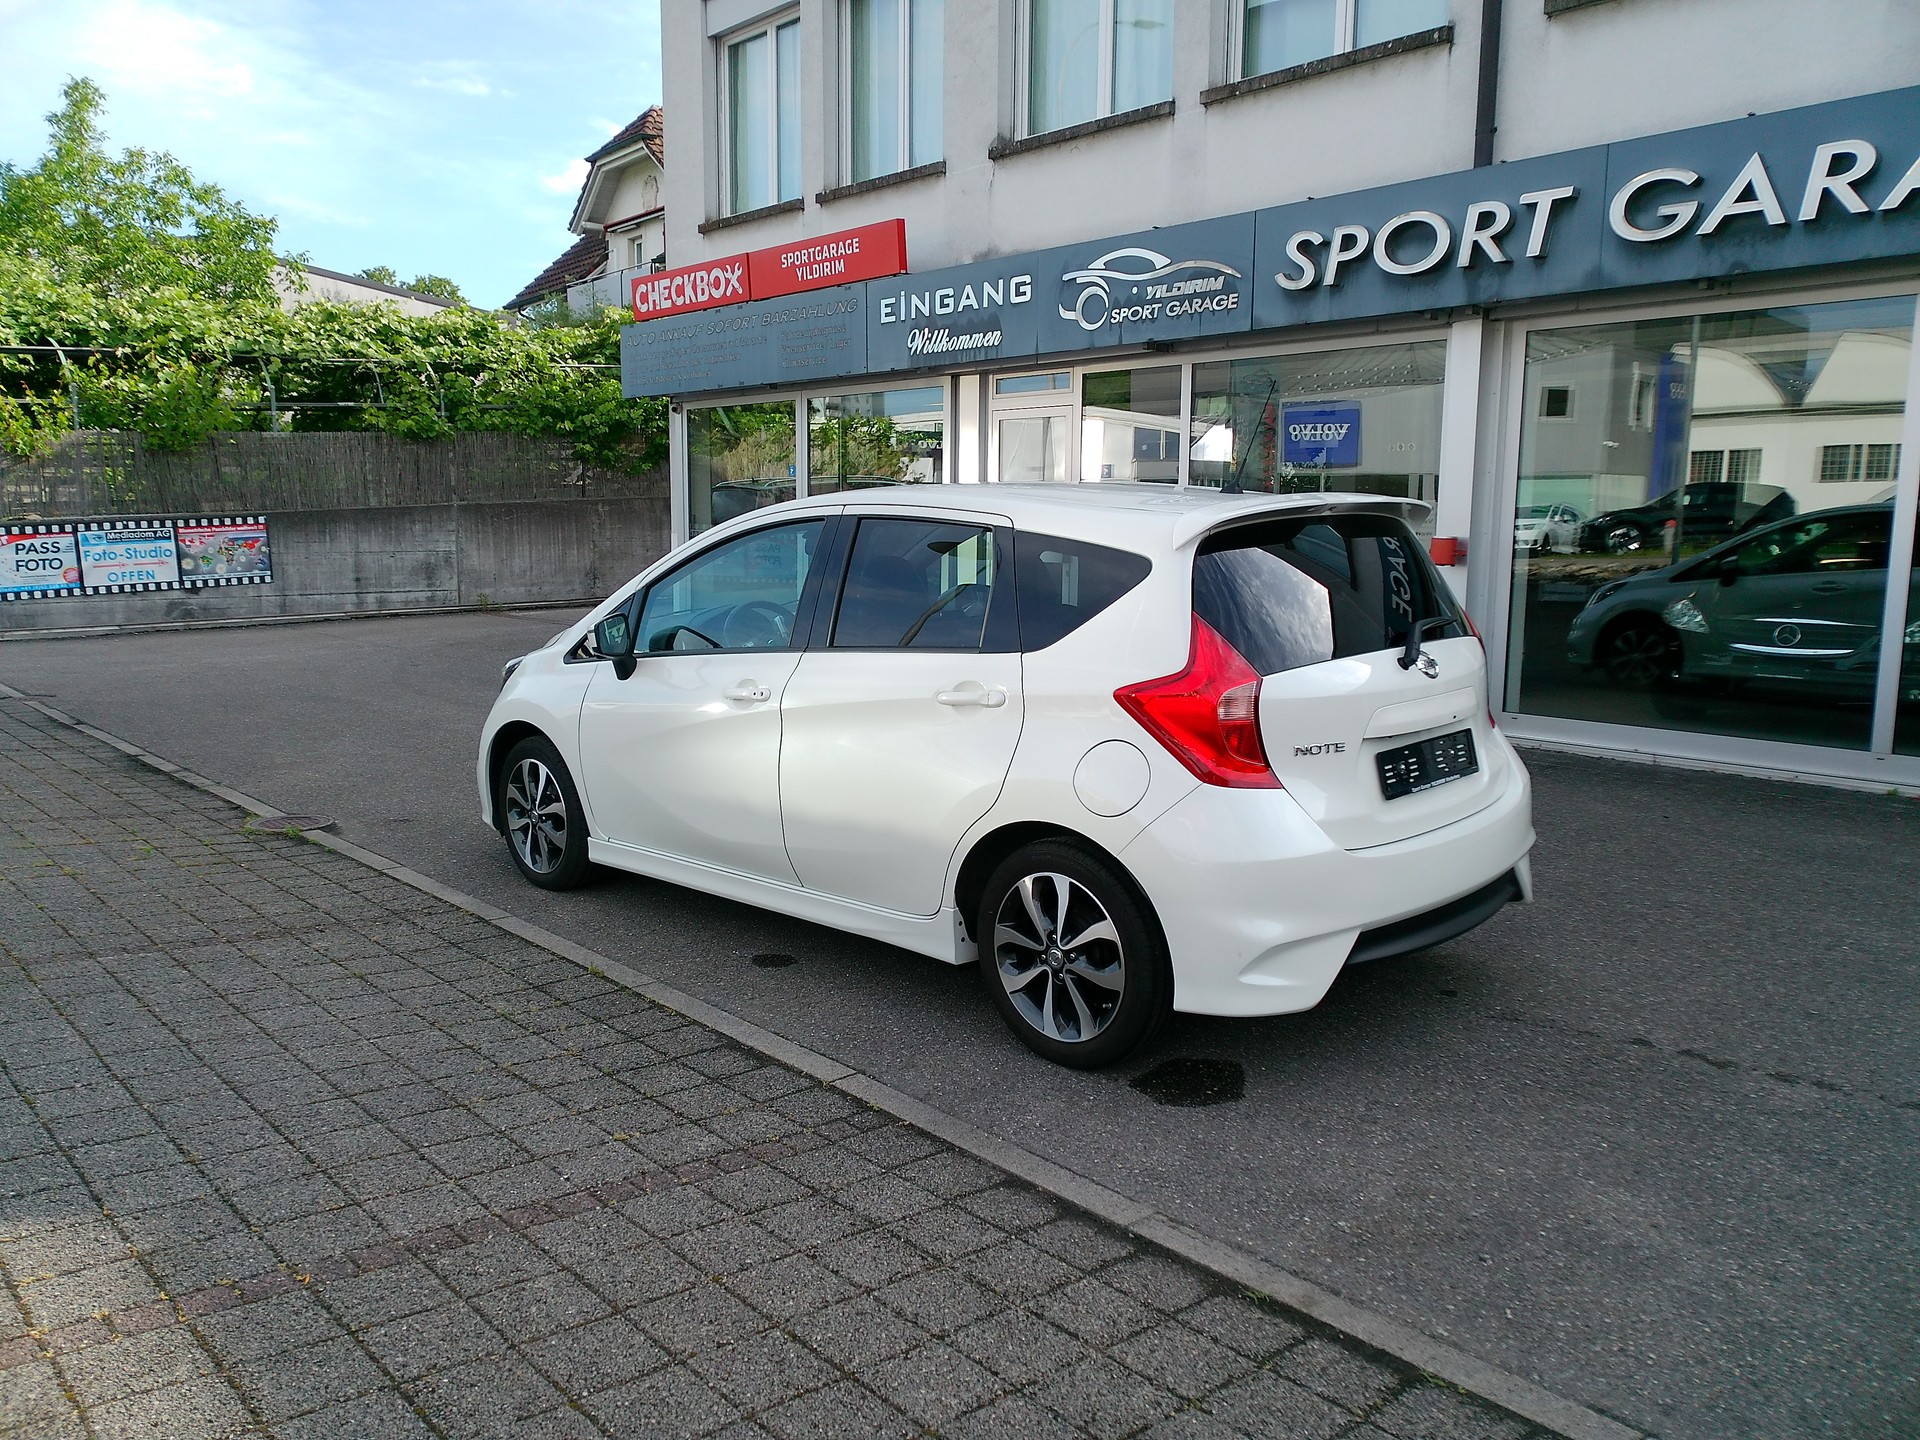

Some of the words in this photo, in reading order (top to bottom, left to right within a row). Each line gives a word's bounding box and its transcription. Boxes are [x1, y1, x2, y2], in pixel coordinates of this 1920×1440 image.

[1274, 185, 1579, 292] SPORT
[781, 238, 860, 268] SPORTGARAGE
[796, 259, 845, 282] YILDIRIM
[635, 262, 743, 313] CHECKBOX
[1146, 275, 1226, 300] YILDIRIM
[707, 314, 759, 335] SOFORT
[761, 298, 858, 327] BARZAHLUNG
[1110, 302, 1162, 325] SPORT
[1165, 292, 1239, 317] GARAGE
[907, 327, 1003, 356] Willkommen
[107, 531, 155, 540] Mediadom
[15, 541, 61, 555] PASS
[83, 546, 173, 562] Foto-Studio
[15, 558, 63, 572] FOTO
[107, 569, 156, 582] OFFEN
[1293, 741, 1346, 757] NOTE
